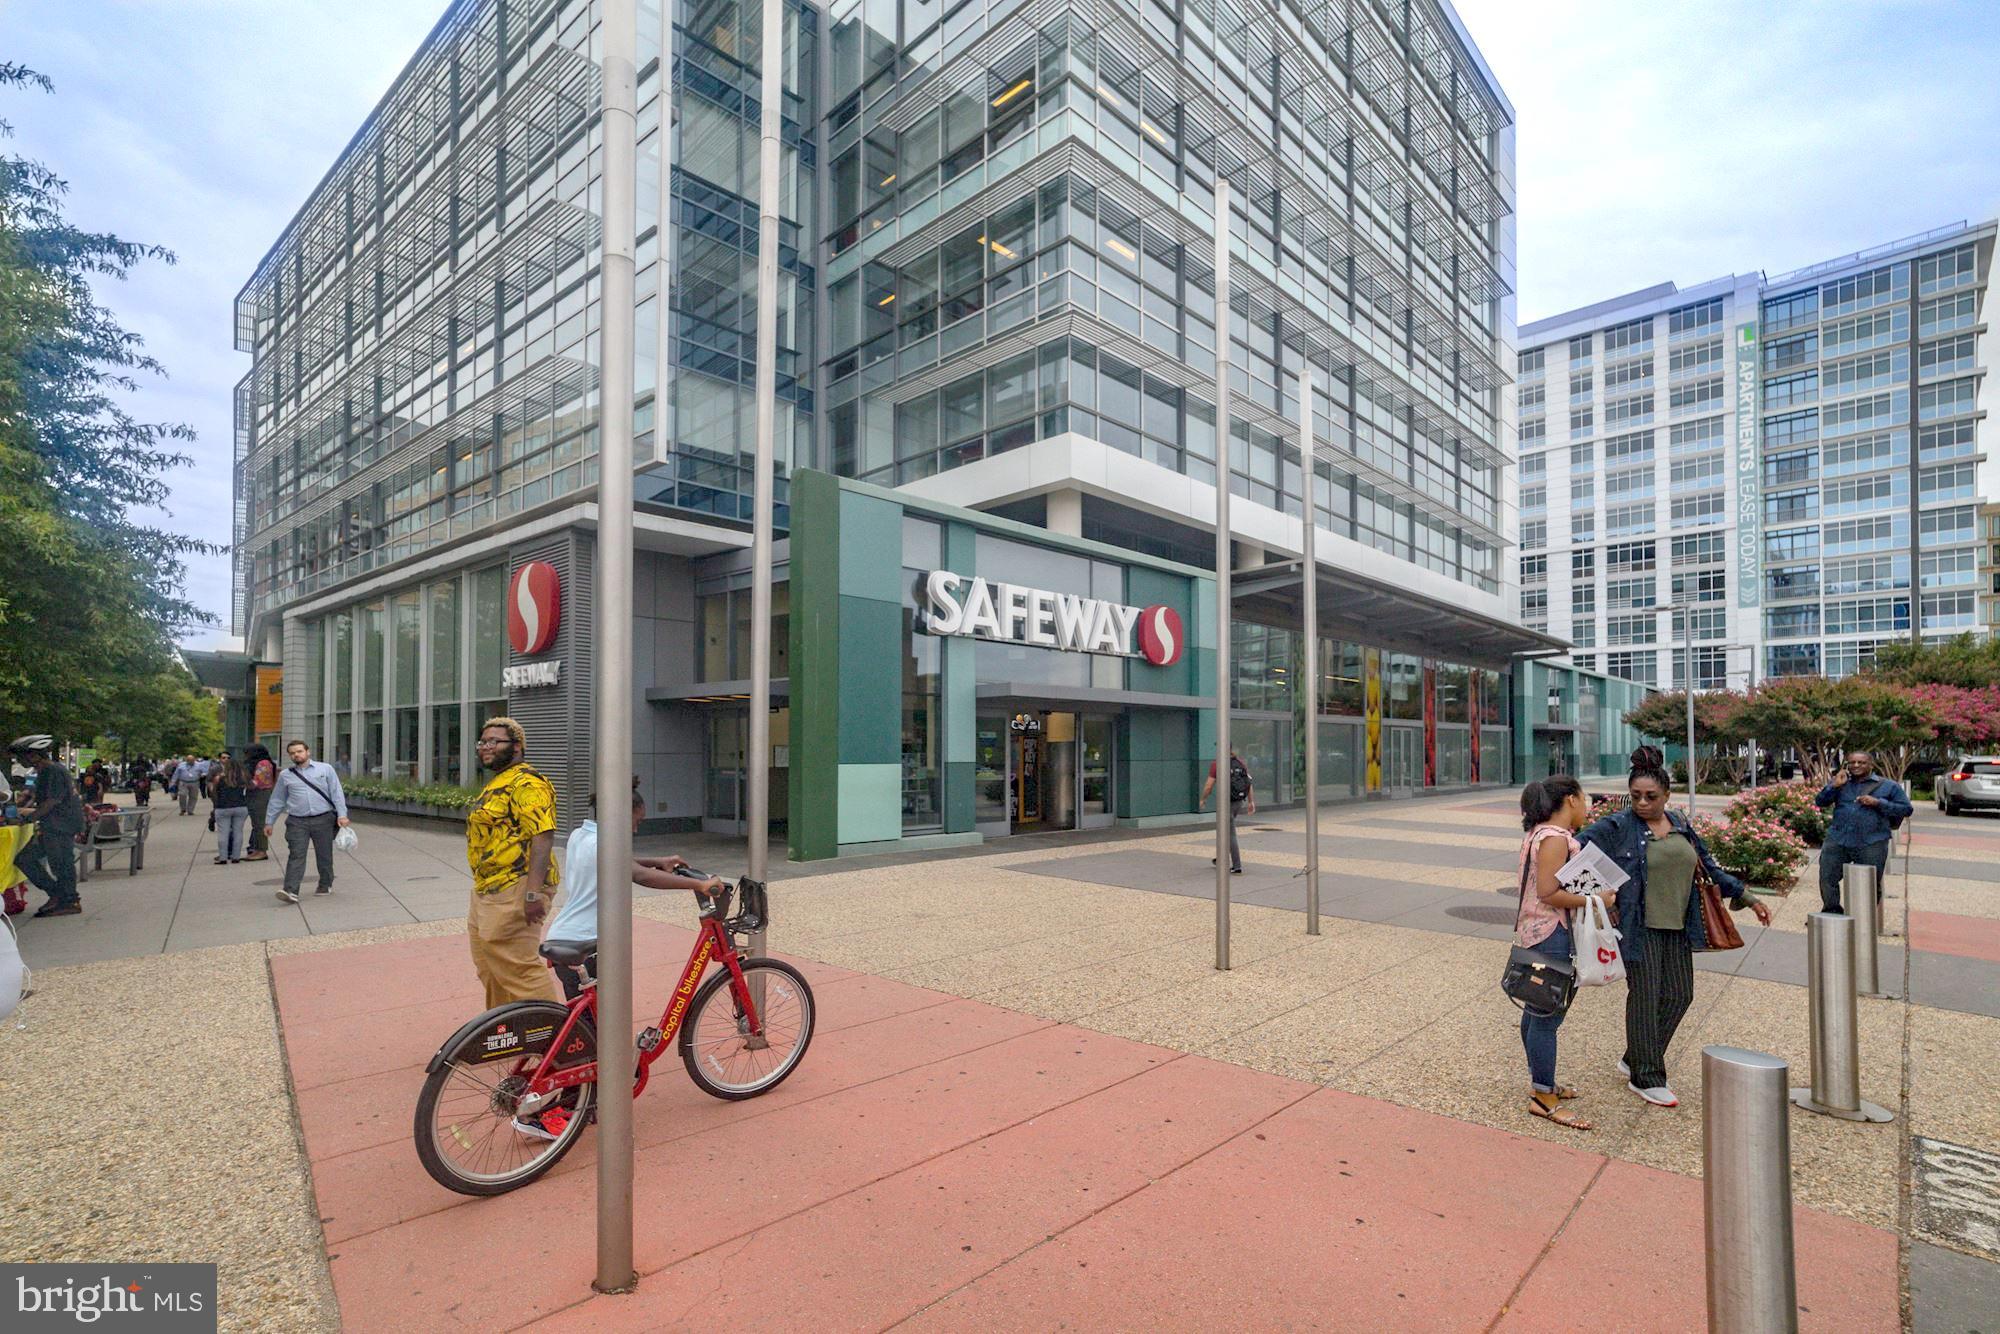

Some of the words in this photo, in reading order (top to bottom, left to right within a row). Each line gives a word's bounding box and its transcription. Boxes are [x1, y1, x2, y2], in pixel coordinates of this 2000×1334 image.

[1739, 361, 1755, 471] APARTMENTS
[1740, 475, 1755, 523] LEASE
[1740, 525, 1756, 579] TODAY!
[927, 570, 1140, 653] SAFEWAY
[503, 660, 560, 688] SAFEWAY
[662, 996, 686, 1040] capital
[679, 941, 712, 995] bikeshare
[483, 1038, 501, 1050] THE
[500, 1036, 518, 1048] APP
